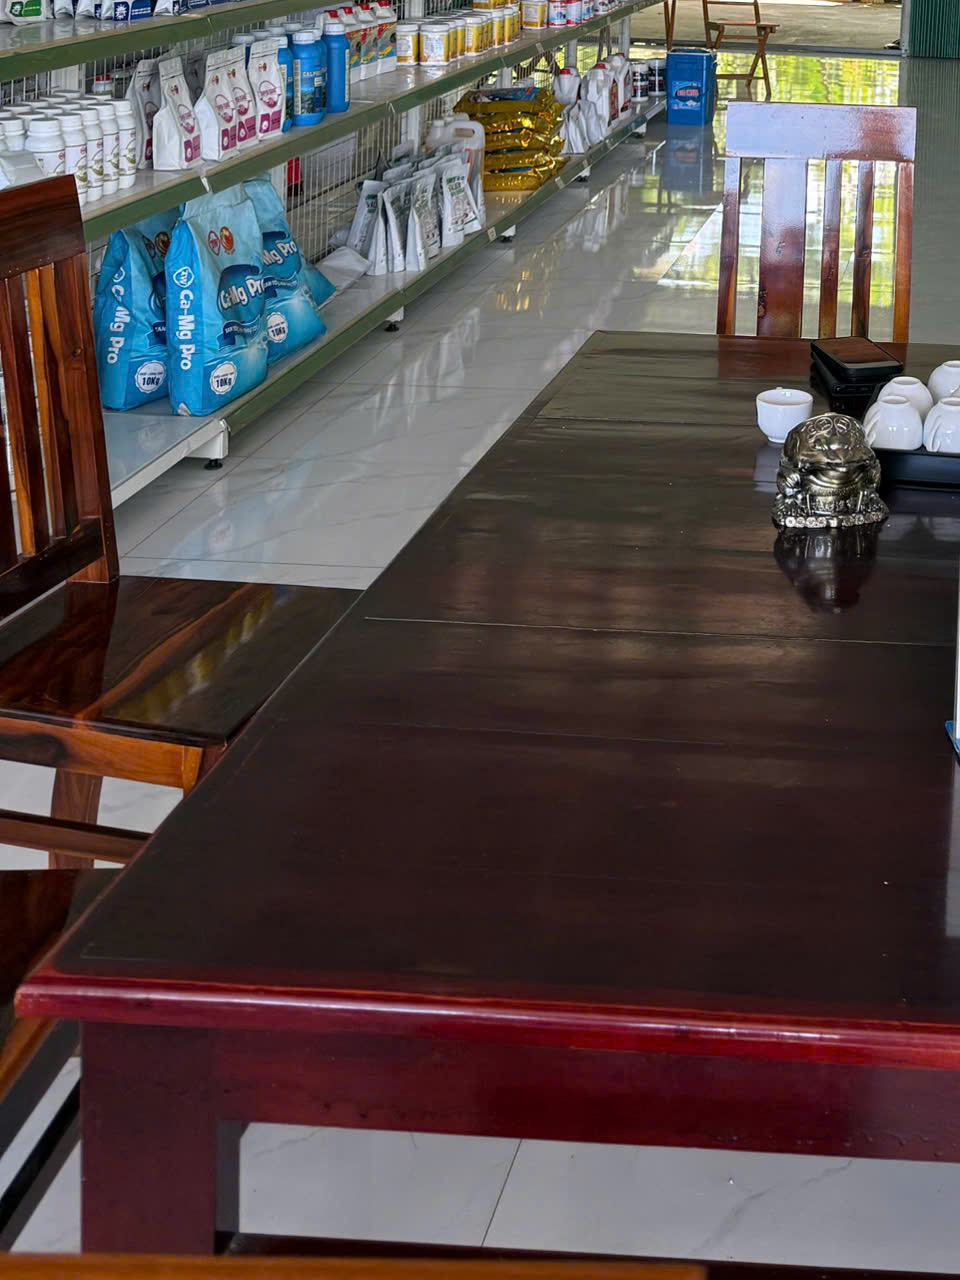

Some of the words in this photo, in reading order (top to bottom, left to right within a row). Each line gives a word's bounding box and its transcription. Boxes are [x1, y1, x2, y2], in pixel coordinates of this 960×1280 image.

[245, 277, 265, 295] Pr
[176, 289, 195, 340] Ca-Mg
[107, 336, 124, 364] Pro
[179, 344, 196, 370] Pro
[142, 376, 160, 387] 10Kg
[216, 376, 232, 388] 10Kg
